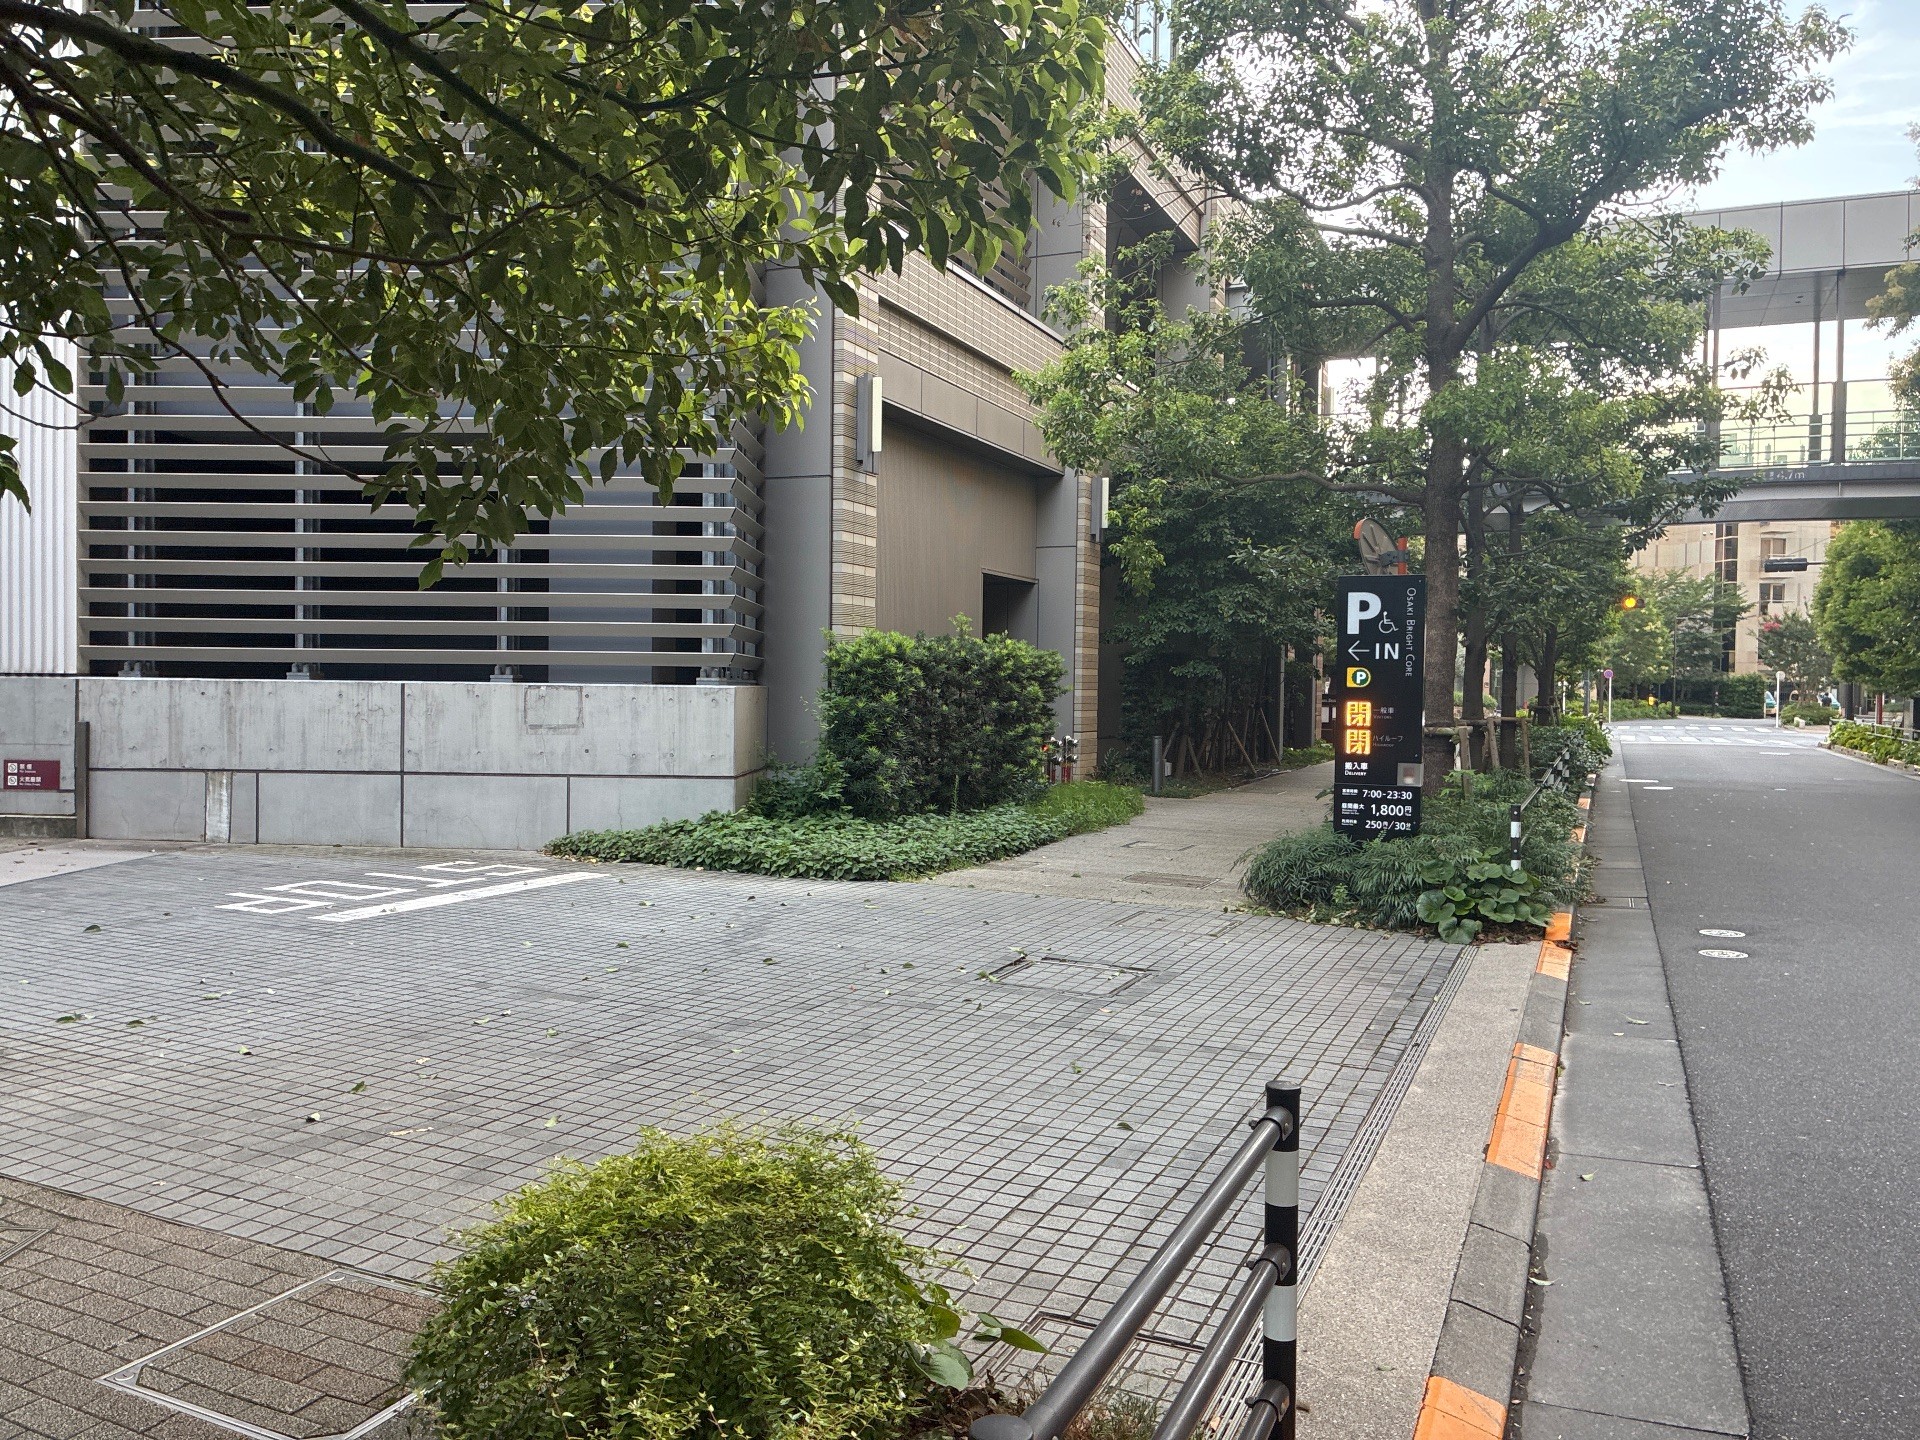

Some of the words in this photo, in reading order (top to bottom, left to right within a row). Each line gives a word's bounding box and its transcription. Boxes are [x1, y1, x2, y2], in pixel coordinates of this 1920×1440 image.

[1346, 591, 1382, 635] P
[1406, 587, 1417, 616] OSAKI
[1405, 619, 1416, 651] BRIGHT
[1375, 642, 1399, 660] IN
[1356, 671, 1367, 684] P
[1405, 654, 1415, 677] CORE
[1346, 701, 1372, 727] 閉
[1345, 729, 1371, 754] 閉
